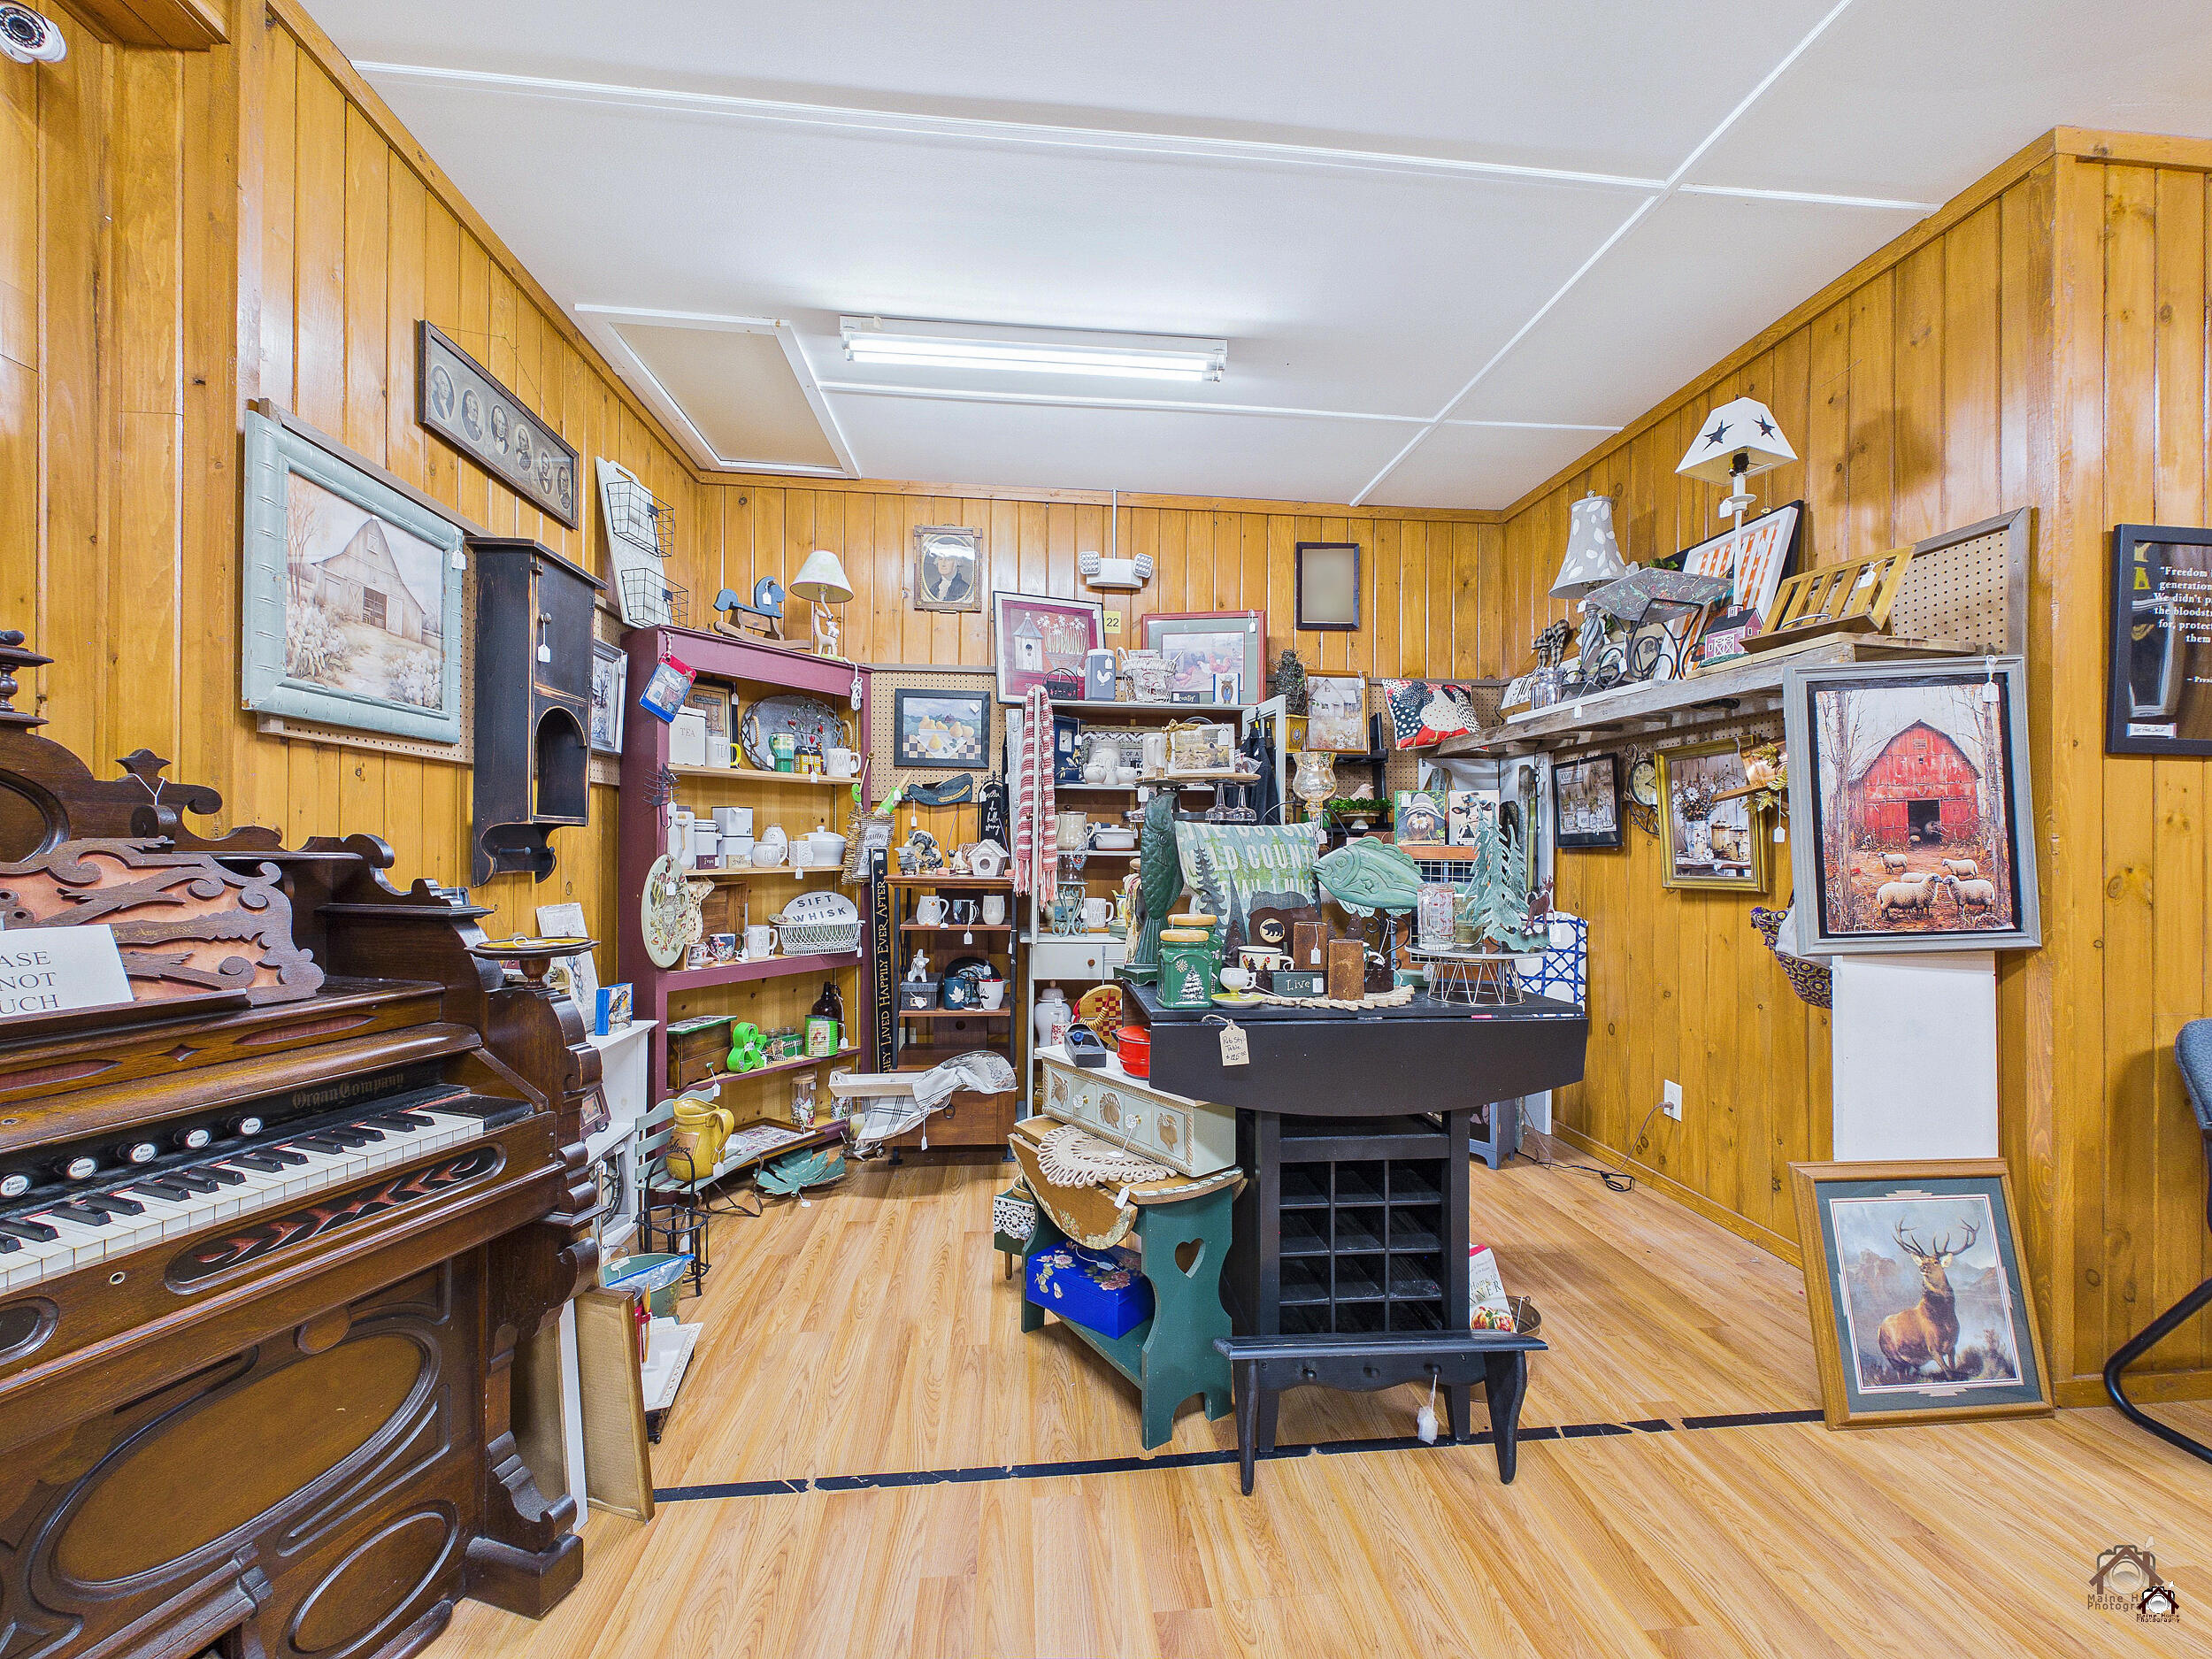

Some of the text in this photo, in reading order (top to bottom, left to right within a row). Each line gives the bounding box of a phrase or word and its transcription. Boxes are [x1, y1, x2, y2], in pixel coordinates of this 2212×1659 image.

[2154, 592, 2170, 602] We
[2173, 593, 2201, 603] didn't
[2154, 605, 2170, 615] the
[1106, 618, 1119, 627] 22
[2159, 618, 2212, 632] for, protec
[2185, 634, 2211, 643] them
[680, 727, 696, 737] TEA
[796, 895, 833, 908] SIFT
[875, 879, 888, 918] AFTER
[793, 906, 847, 923] WHISK
[877, 918, 888, 955] EVER
[0, 972, 57, 992] NOT
[879, 959, 890, 1007] HAPPILY
[1286, 979, 1310, 991] Live
[879, 1010, 892, 1046] LIVED
